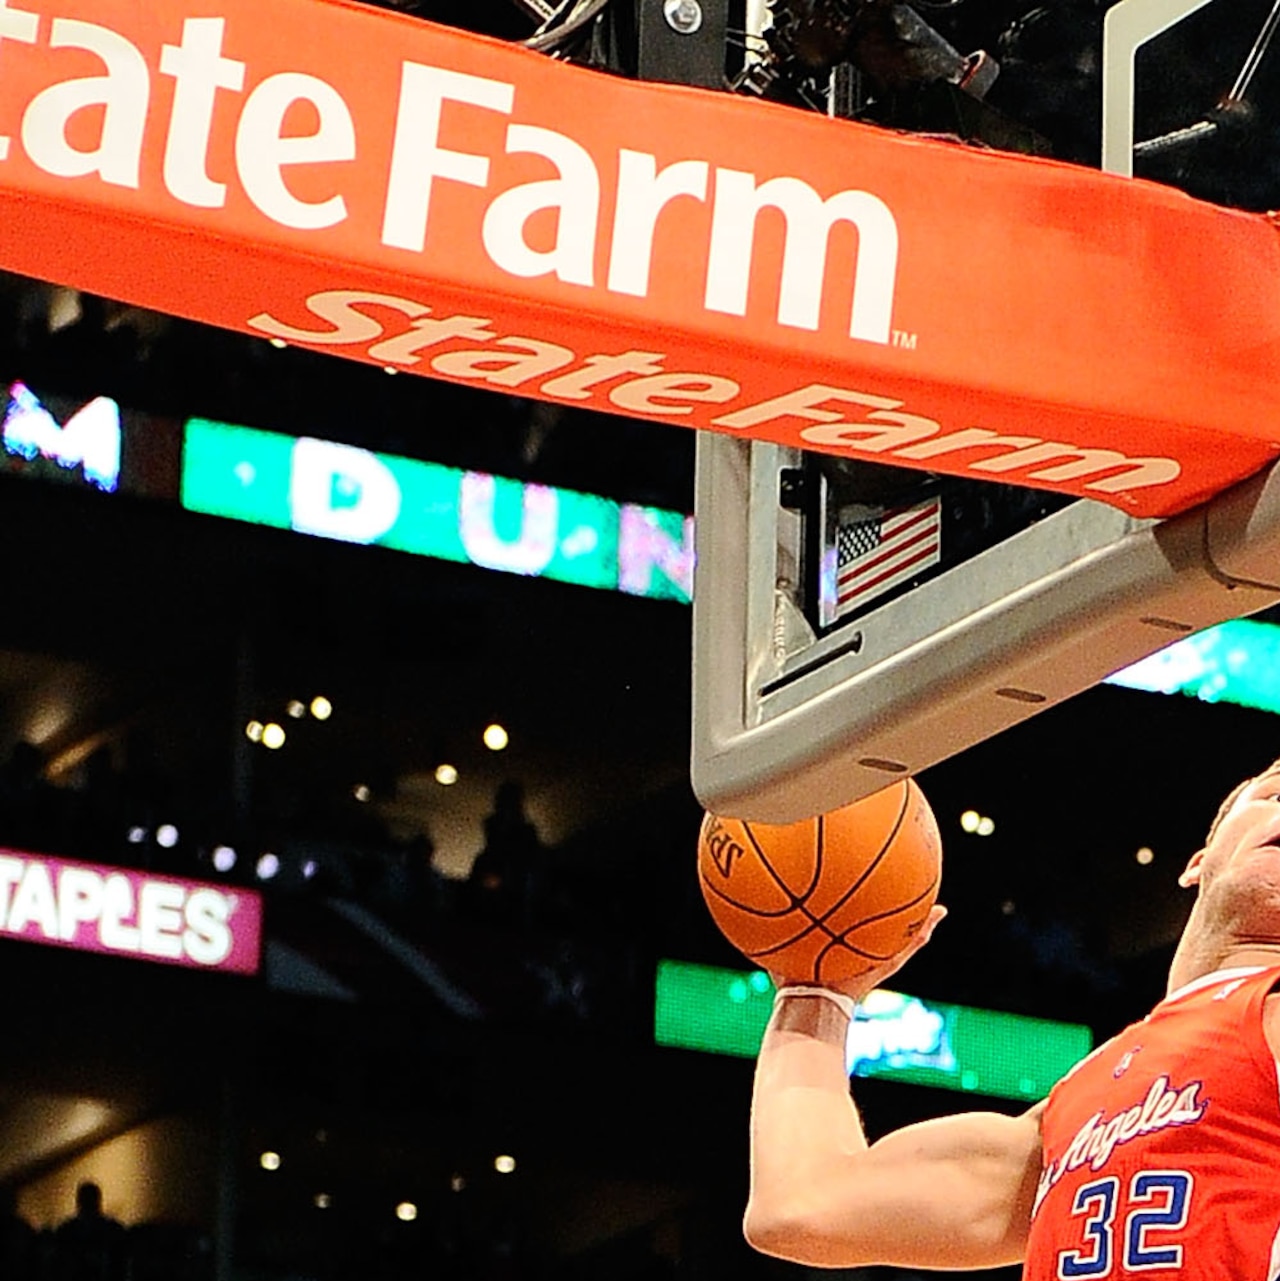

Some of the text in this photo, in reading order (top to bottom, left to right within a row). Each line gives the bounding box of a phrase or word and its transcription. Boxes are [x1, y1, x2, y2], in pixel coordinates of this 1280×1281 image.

[382, 61, 899, 345] Farm
[247, 289, 1181, 494] State Farm
[1052, 1075, 1211, 1184] Angeles
